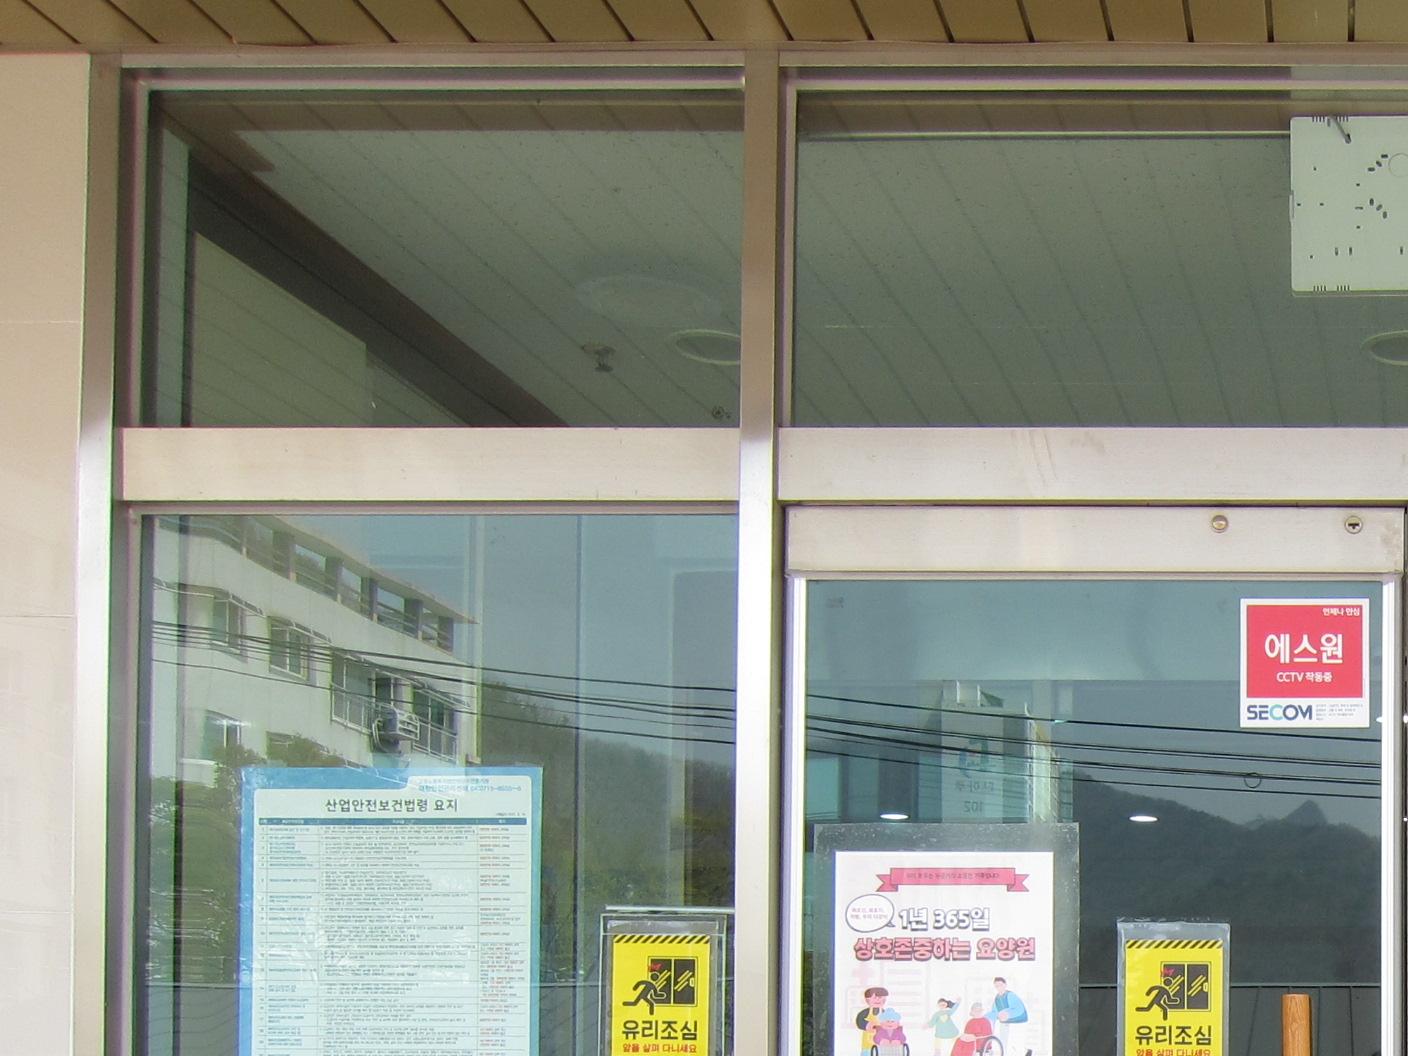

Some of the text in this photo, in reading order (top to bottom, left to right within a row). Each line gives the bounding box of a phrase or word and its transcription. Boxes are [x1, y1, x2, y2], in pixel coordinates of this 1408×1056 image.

[1322, 607, 1360, 616] 언제나 안심
[1264, 633, 1343, 664] 에스원
[1276, 672, 1333, 683] CCTV 작동중
[1247, 703, 1313, 721] SECOM
[325, 798, 458, 813] 산업안전보건법령 요지
[899, 907, 990, 932] 1년 365일
[854, 937, 1036, 961] 상호존중하는 요양원
[622, 1020, 698, 1041] 유리조심
[1135, 1025, 1212, 1046] 유리조심
[623, 1043, 697, 1054] 앞을 살펴 다니세요
